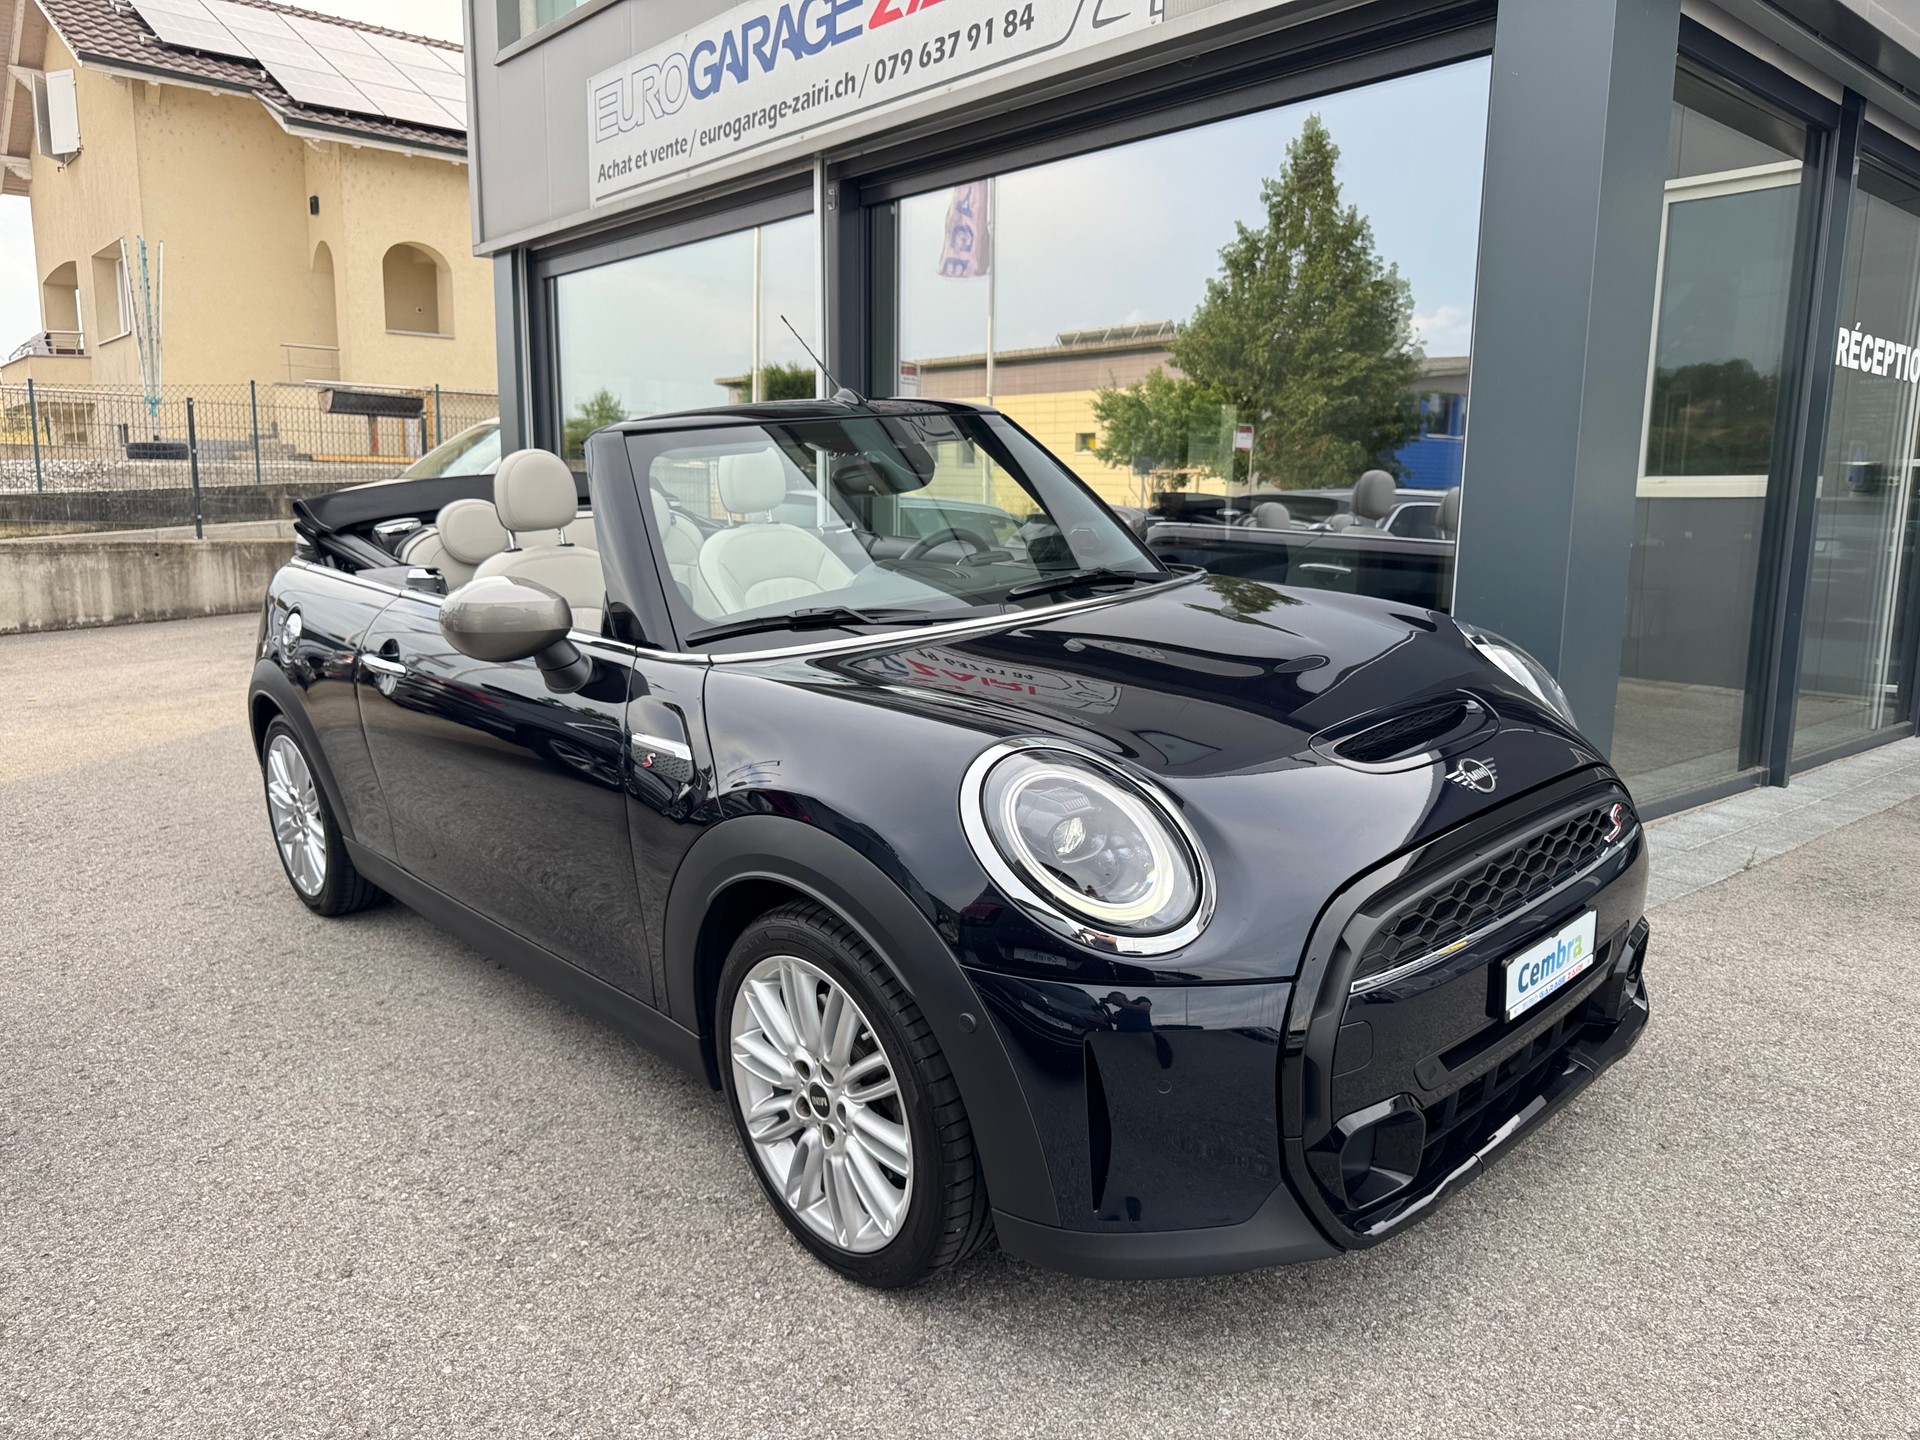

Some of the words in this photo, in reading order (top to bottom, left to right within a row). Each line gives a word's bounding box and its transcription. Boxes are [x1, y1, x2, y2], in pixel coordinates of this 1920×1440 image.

[597, 151, 632, 183] Achat
[635, 151, 648, 170] et
[650, 136, 688, 164] vente
[689, 129, 697, 158] /
[700, 72, 856, 146] eurogarage-zairi.ch
[858, 63, 870, 98] /
[874, 48, 913, 84] 079
[919, 30, 961, 68] 637
[967, 17, 994, 51] 91
[1003, 2, 1035, 38] 84
[1835, 322, 1920, 384] RÉCEPTIO
[1466, 766, 1489, 782] MINI
[1518, 934, 1583, 993] Cembra
